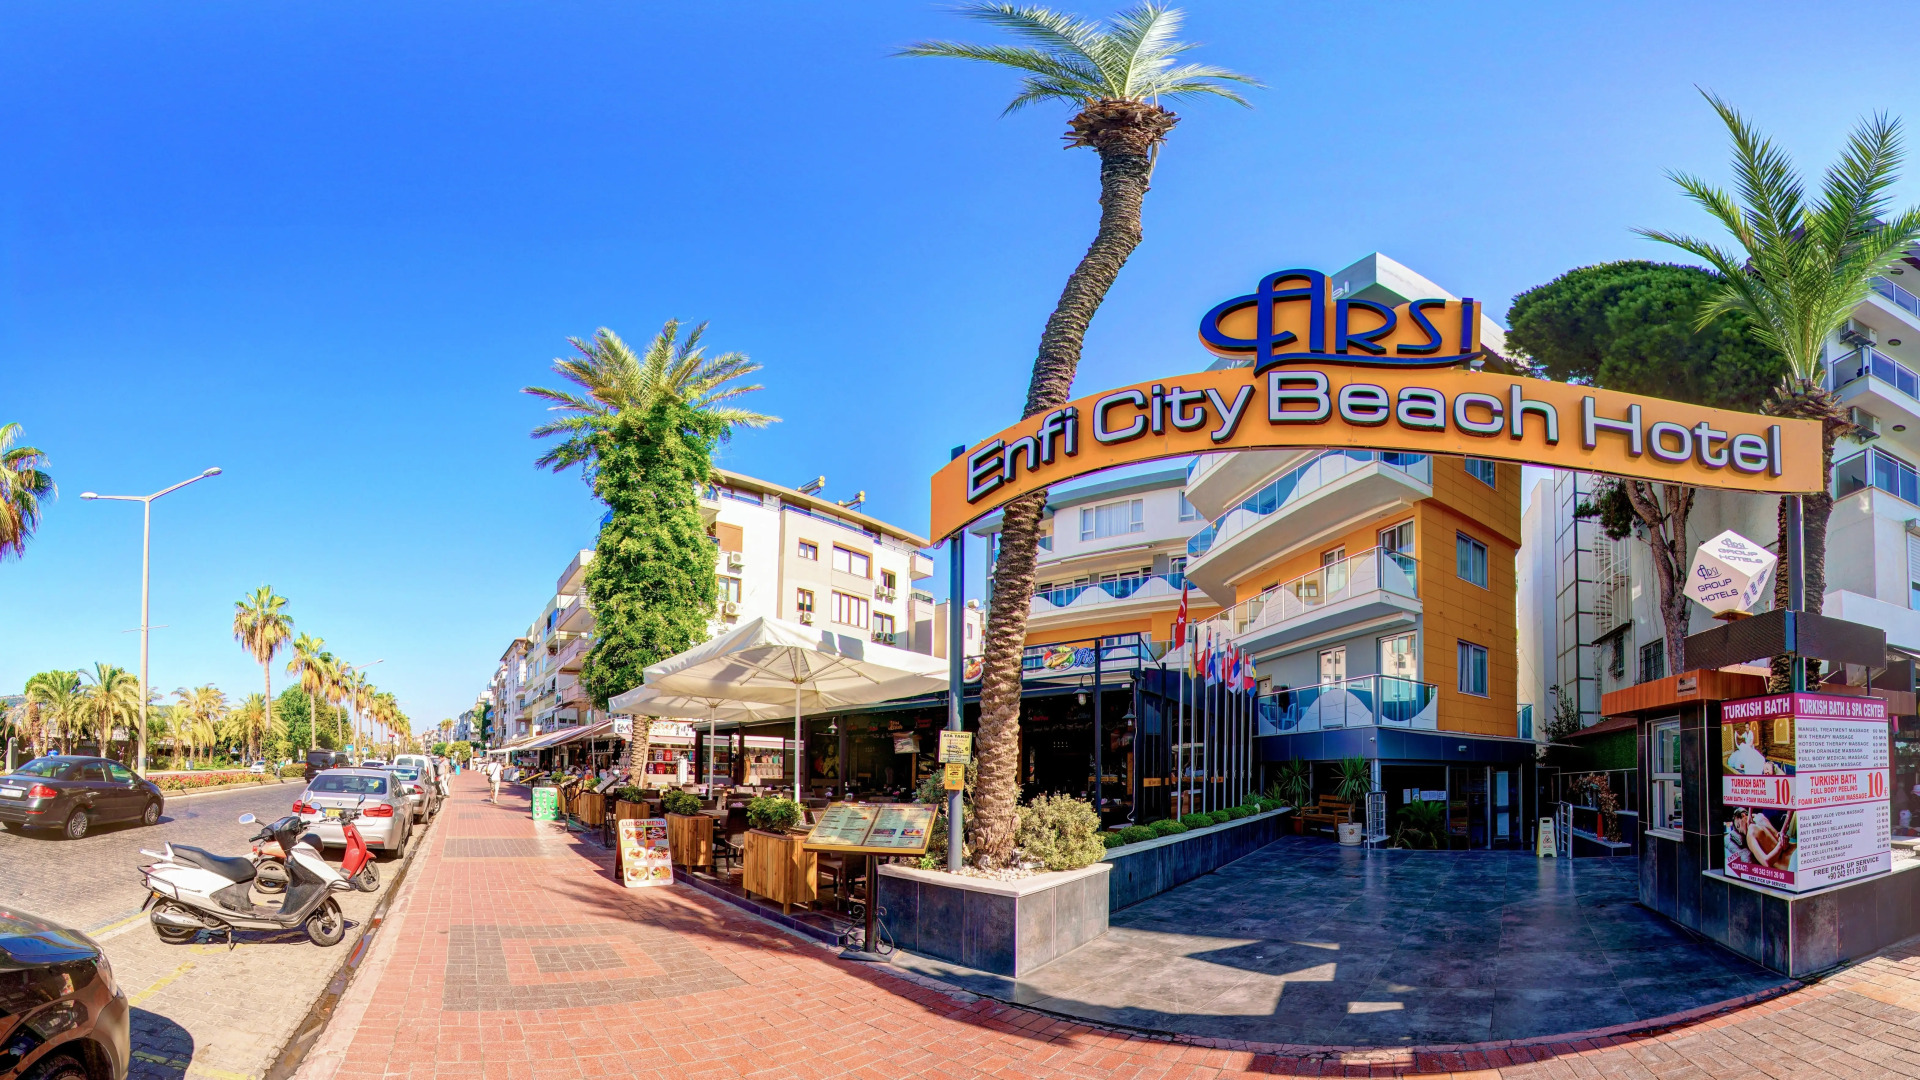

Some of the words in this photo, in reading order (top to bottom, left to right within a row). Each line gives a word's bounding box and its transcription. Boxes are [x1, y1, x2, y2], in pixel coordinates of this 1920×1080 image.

[967, 406, 1077, 504] Enfi
[1092, 384, 1255, 444] City
[1267, 370, 1559, 446] Beach
[1581, 396, 1782, 478] Hotel
[1718, 548, 1758, 556] GROUP
[1719, 554, 1763, 564] HOTELS
[1698, 578, 1732, 592] GROUP
[1701, 589, 1738, 602] HOTELS
[1724, 701, 1761, 719] TURKISH
[1764, 698, 1790, 714] BATH
[1799, 699, 1828, 714] TURKISH
[1829, 701, 1845, 715] BATH
[1846, 702, 1850, 715] &
[1852, 703, 1862, 716] SPA
[1864, 704, 1884, 717] CENTER
[1731, 779, 1751, 788] TURKISH
[1753, 779, 1765, 788] BATH
[1810, 776, 1839, 787] TURKISH
[1841, 774, 1856, 784] BATH
[1867, 772, 1883, 798] 10
[1775, 779, 1790, 805] 10
[1813, 867, 1829, 876] FREE
[1831, 864, 1845, 872] PICK
[1856, 856, 1879, 866] SERVICE
[1837, 870, 1846, 878] 242
